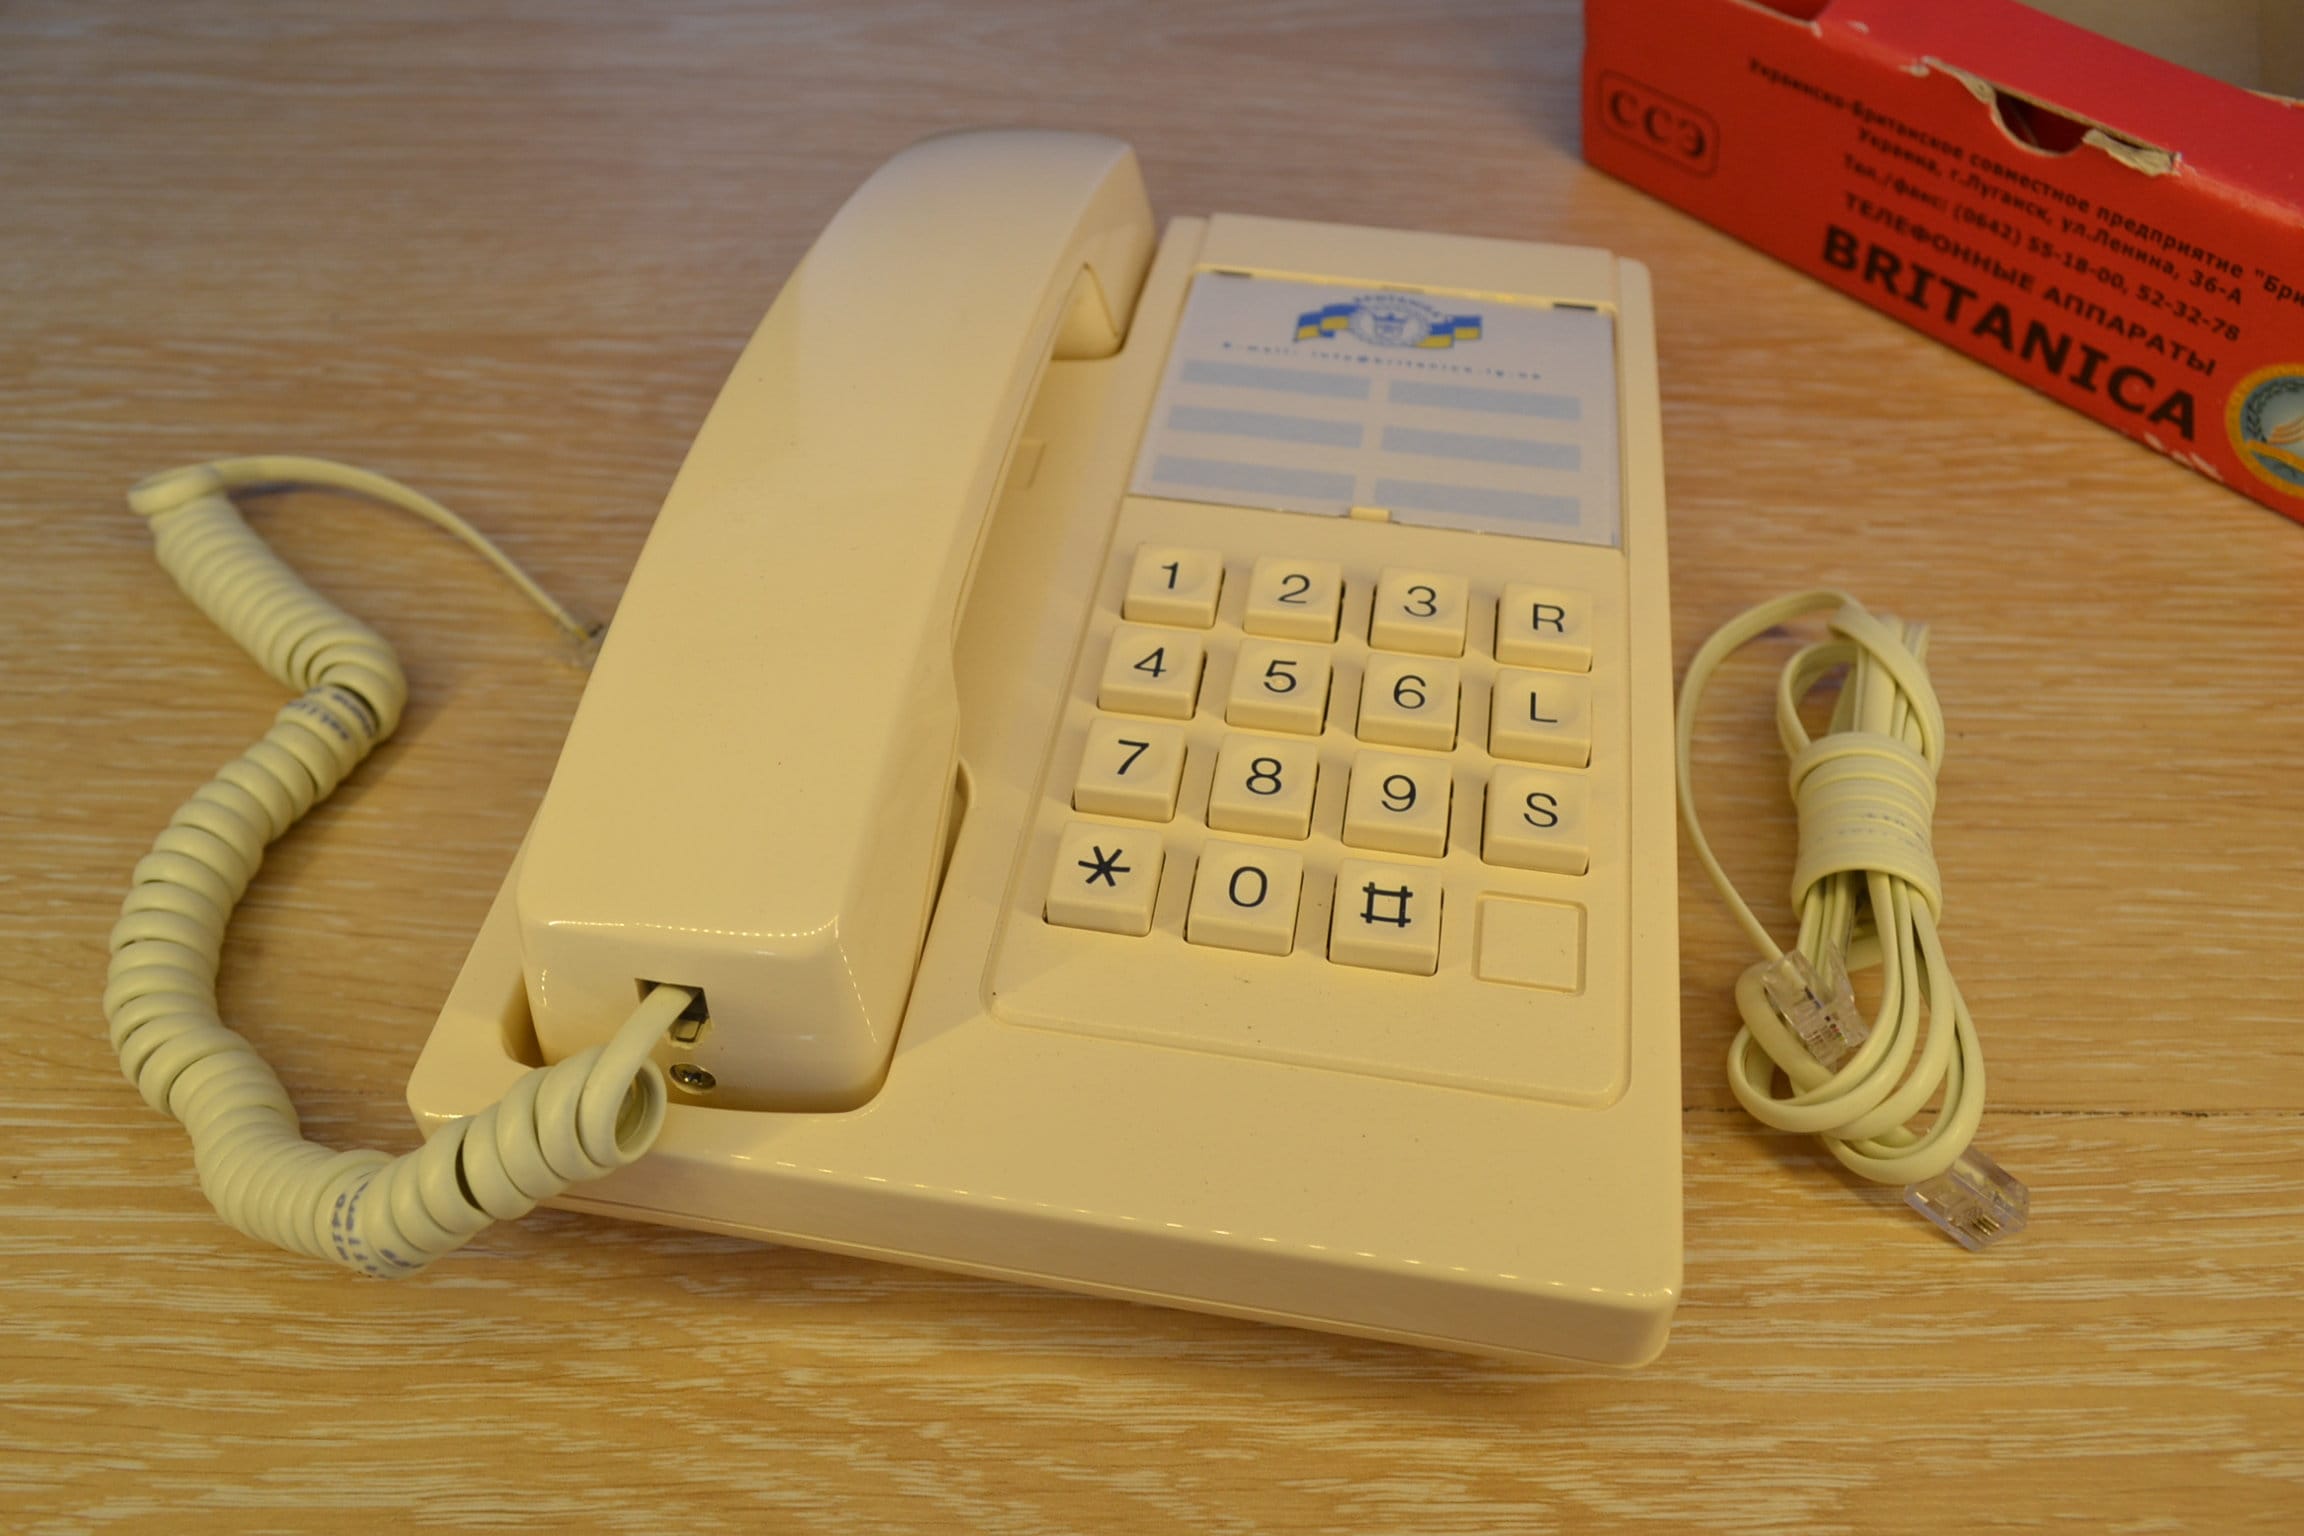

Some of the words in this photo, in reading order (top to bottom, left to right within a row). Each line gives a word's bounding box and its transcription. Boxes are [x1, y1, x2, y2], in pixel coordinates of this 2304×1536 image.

[1969, 153, 2090, 213] совместное
[2097, 206, 2244, 280] предприятие
[1846, 191, 2035, 292] ТЕЛЕФОННЫЕ
[2042, 286, 2217, 377] АППАРАТЫ
[1952, 203, 2022, 247] (0642)
[2136, 283, 2241, 342] 52-32-78
[1822, 224, 2195, 441] BRITANICA
[1160, 562, 1179, 590] 1
[1278, 574, 1311, 604] 2
[1403, 585, 1437, 618] 3
[1532, 603, 1565, 633] R
[1133, 647, 1167, 678] 4
[1263, 659, 1297, 694] 5
[1393, 674, 1426, 710] 6
[1529, 691, 1558, 724] L
[1116, 739, 1150, 776] 7
[1245, 757, 1282, 796] 8
[1381, 774, 1417, 813] 9
[1523, 792, 1558, 828] S
[1228, 866, 1268, 908] 0
